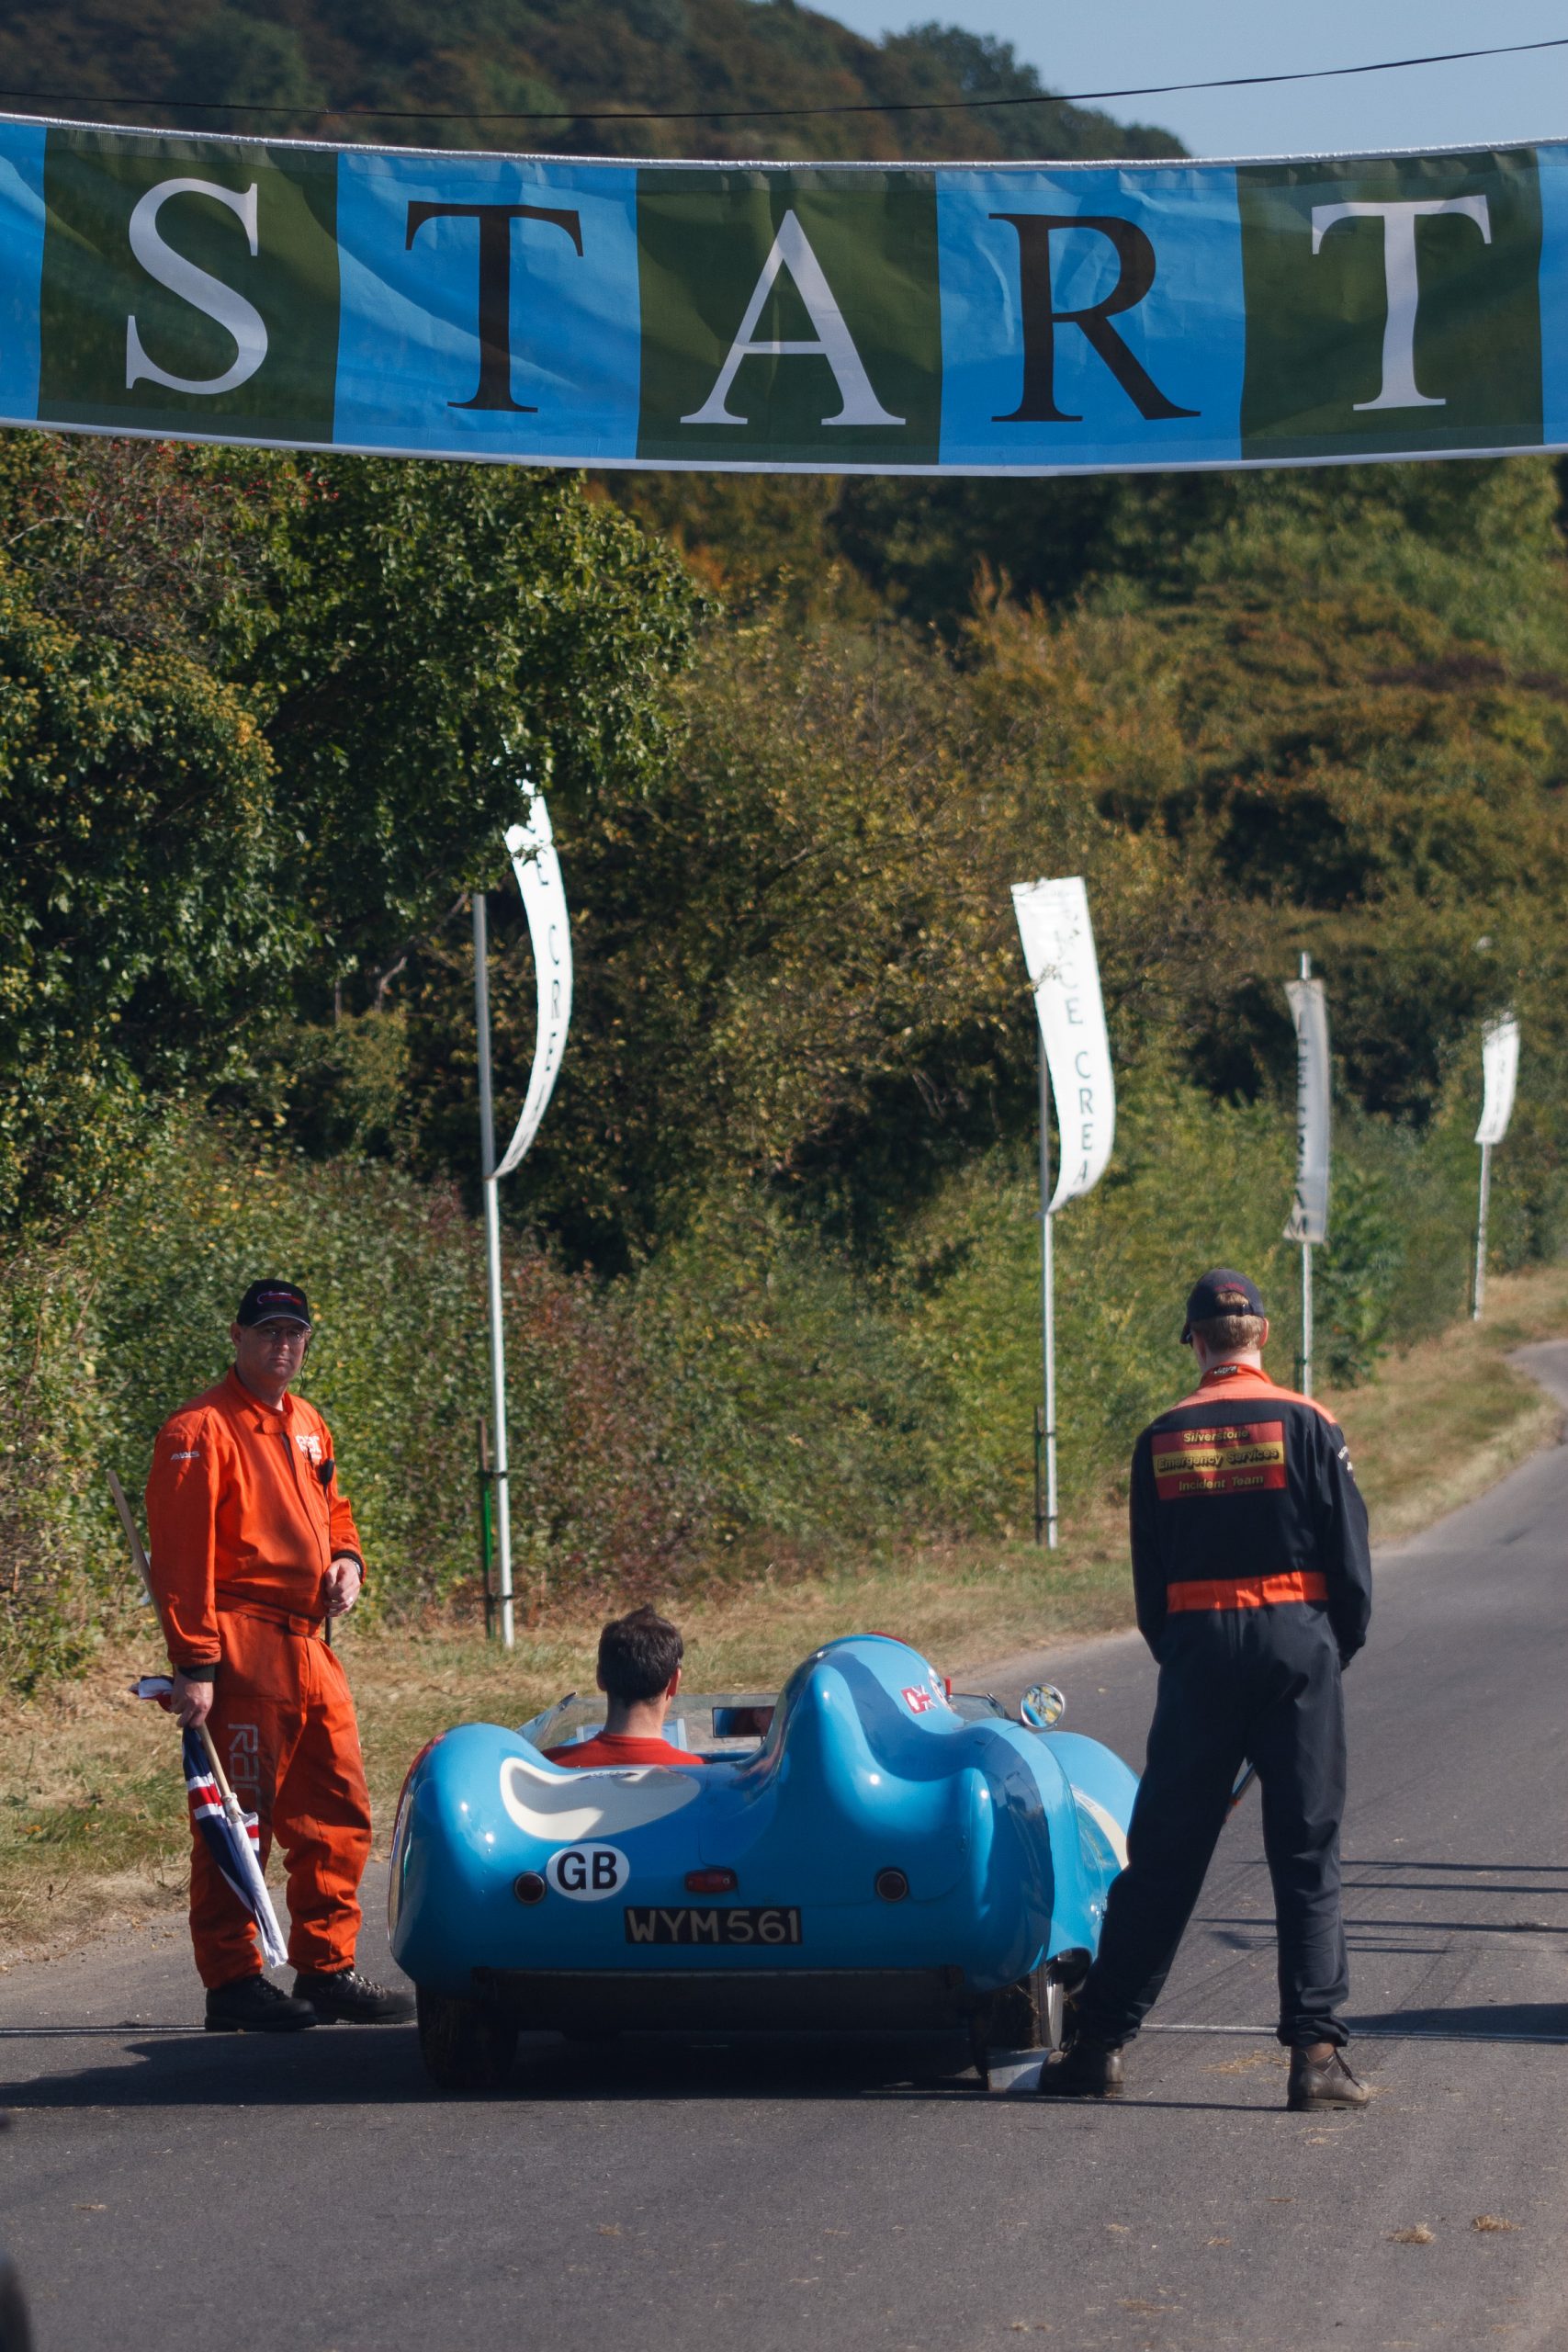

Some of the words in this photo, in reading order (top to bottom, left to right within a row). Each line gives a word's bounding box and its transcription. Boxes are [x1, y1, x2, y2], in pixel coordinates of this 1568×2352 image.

[126, 176, 1494, 428] START
[1073, 1050, 1095, 1187] CREA
[1183, 1430, 1249, 1443] Silverstone
[1158, 1453, 1223, 1472] Emergency
[1226, 1448, 1280, 1464] Services
[1179, 1479, 1225, 1491] Incident
[1232, 1475, 1264, 1487] Team
[557, 1850, 618, 1891] GB
